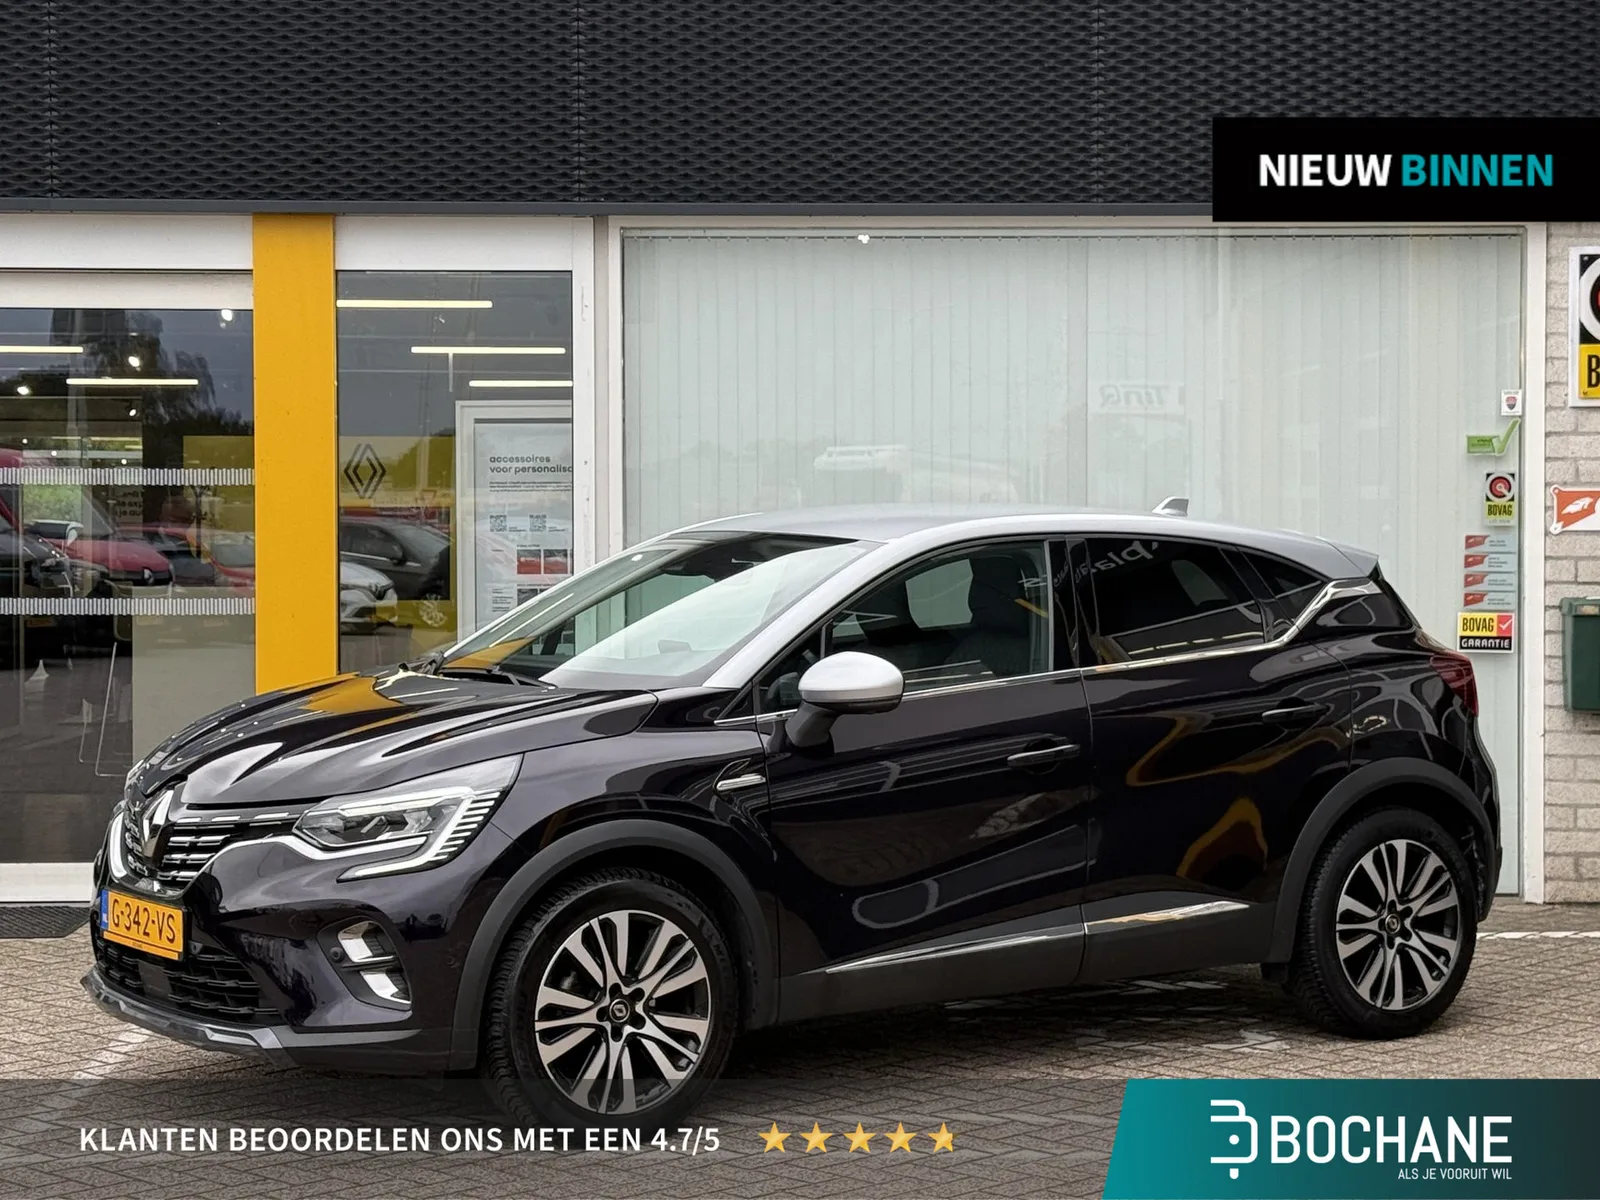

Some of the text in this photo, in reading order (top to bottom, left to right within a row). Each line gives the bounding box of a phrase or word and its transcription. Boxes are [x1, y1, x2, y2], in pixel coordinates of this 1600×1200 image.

[489, 454, 551, 464] accessoires
[1487, 504, 1513, 517] BOVAG
[1462, 617, 1494, 633] BOVAG
[1461, 638, 1510, 649] GARANTIE
[112, 898, 176, 944] G-342-VS
